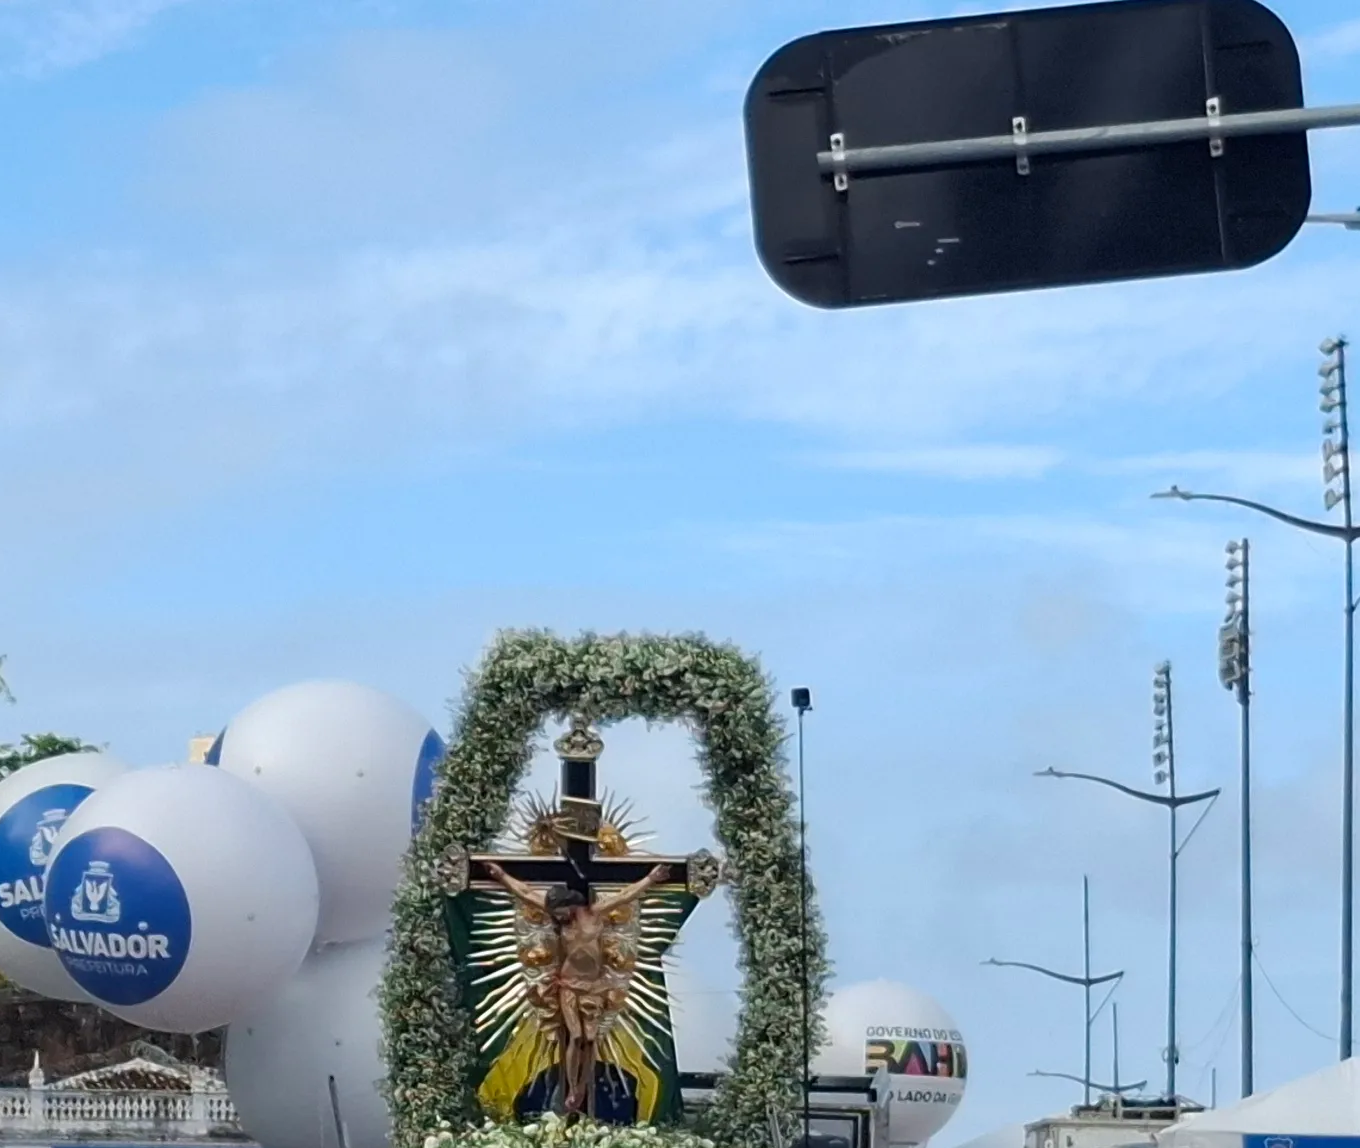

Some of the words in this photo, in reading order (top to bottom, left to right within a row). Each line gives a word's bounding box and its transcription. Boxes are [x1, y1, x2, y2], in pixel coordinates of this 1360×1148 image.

[50, 923, 172, 959] SALVADOR
[866, 1026, 931, 1039] GOVERNO
[897, 1090, 931, 1102] LADO
